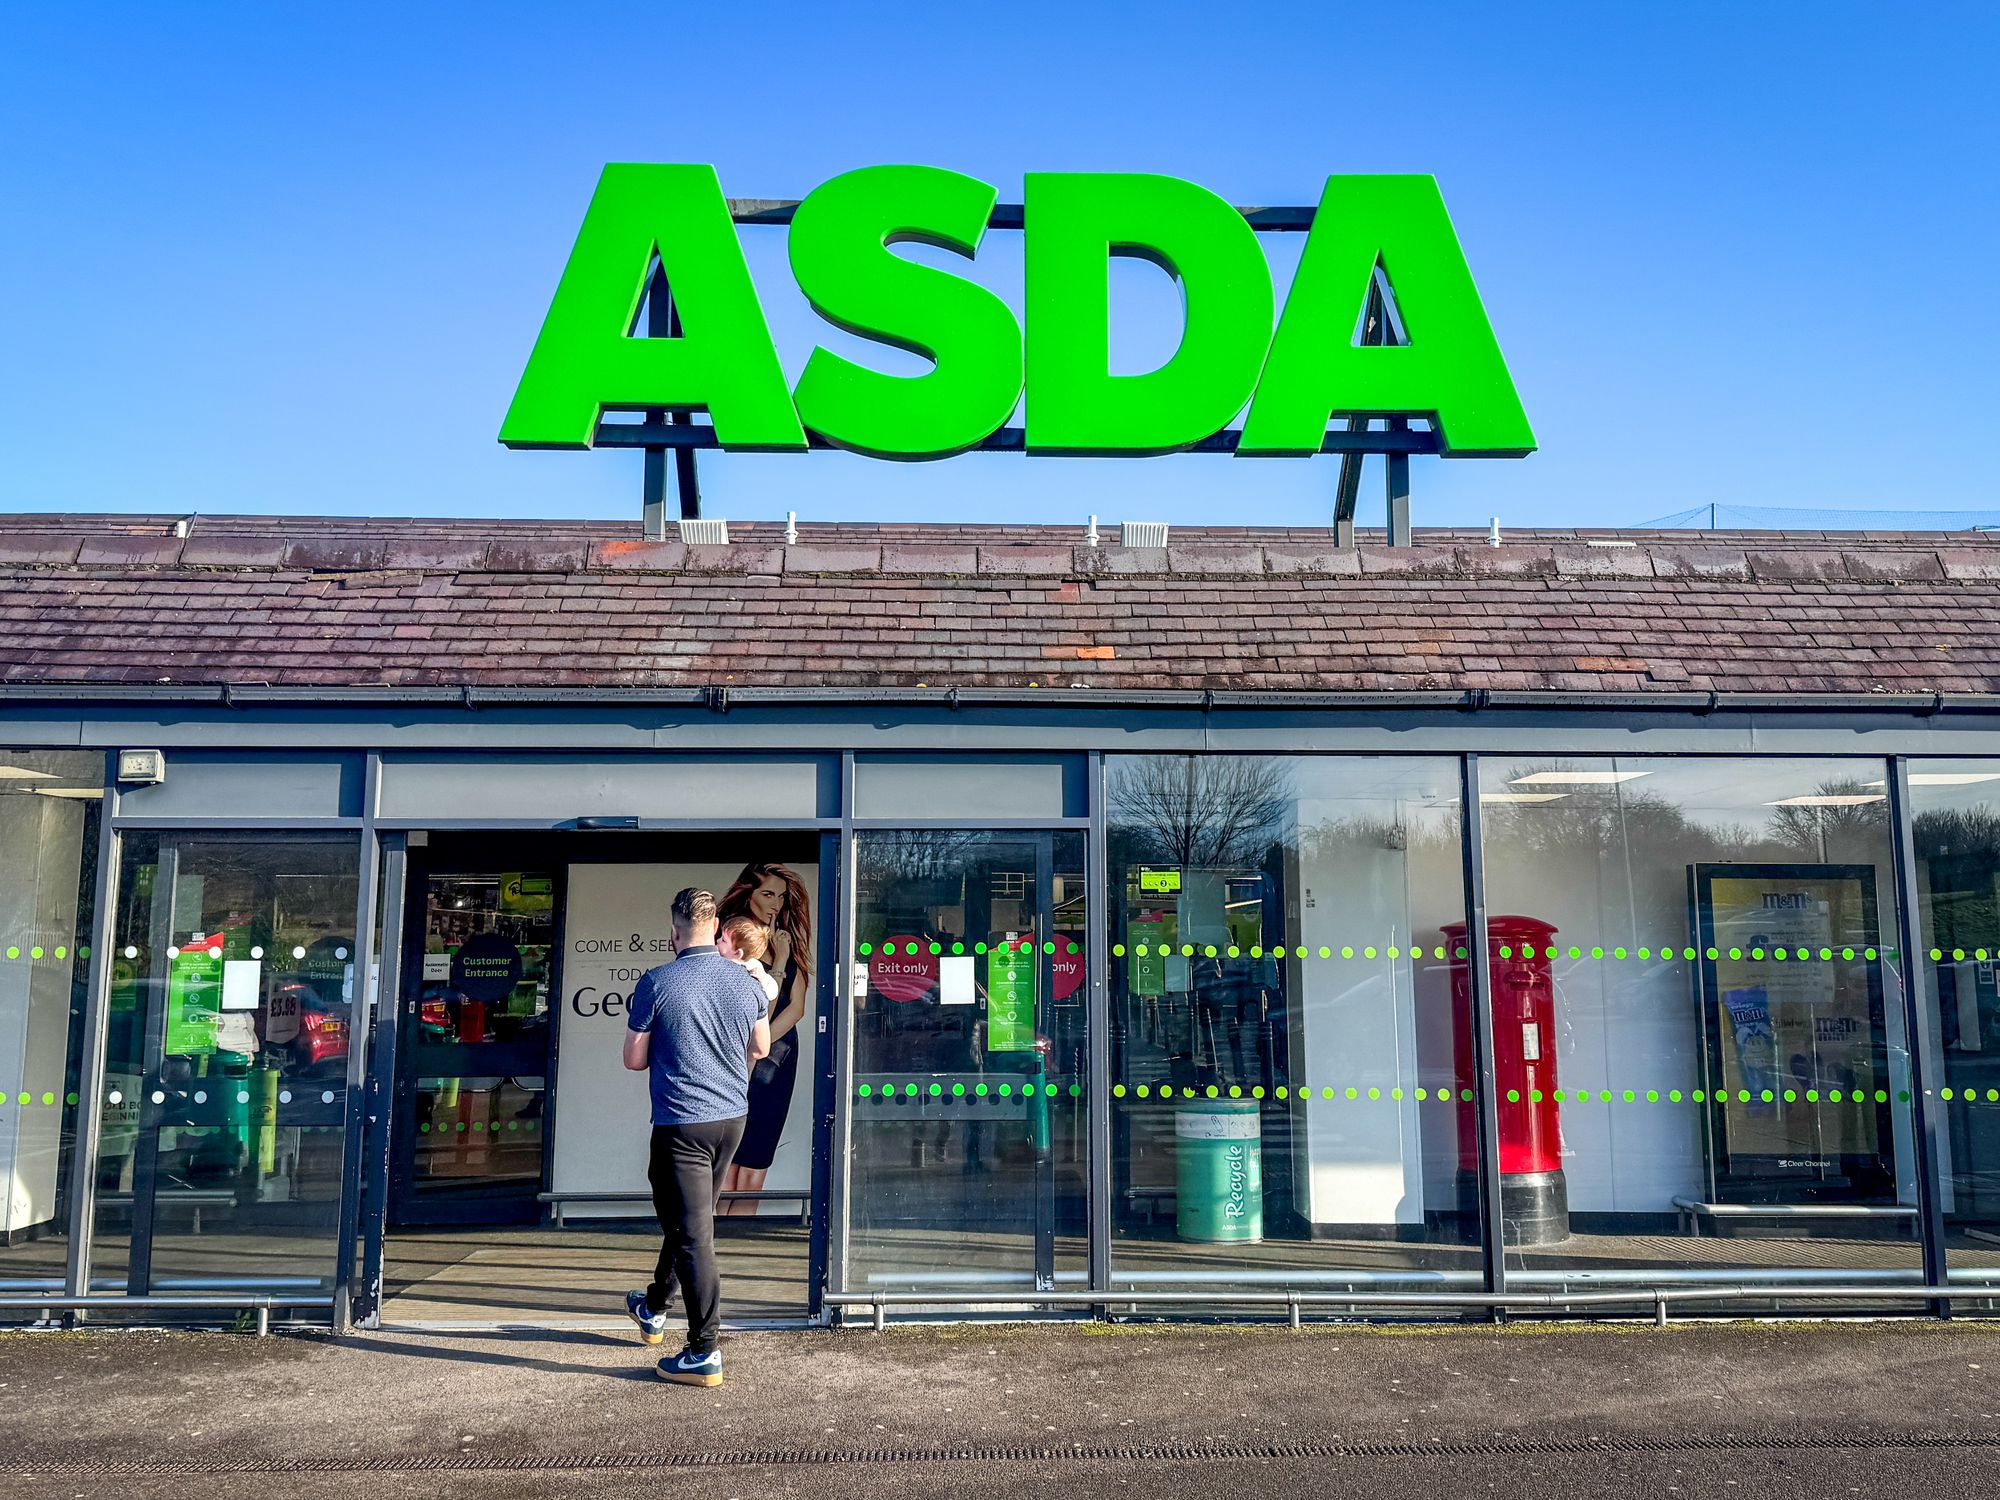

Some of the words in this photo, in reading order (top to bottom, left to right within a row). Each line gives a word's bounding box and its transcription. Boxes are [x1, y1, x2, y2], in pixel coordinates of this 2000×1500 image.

[498, 161, 1538, 460] ASDA
[574, 940, 623, 953] COME
[628, 933, 644, 952] &
[463, 957, 512, 966] Customer
[465, 968, 509, 977] Entrance
[608, 968, 649, 981] TOD
[878, 963, 900, 974] Exit
[903, 963, 928, 975] only
[1225, 1145, 1247, 1219] Recycle
